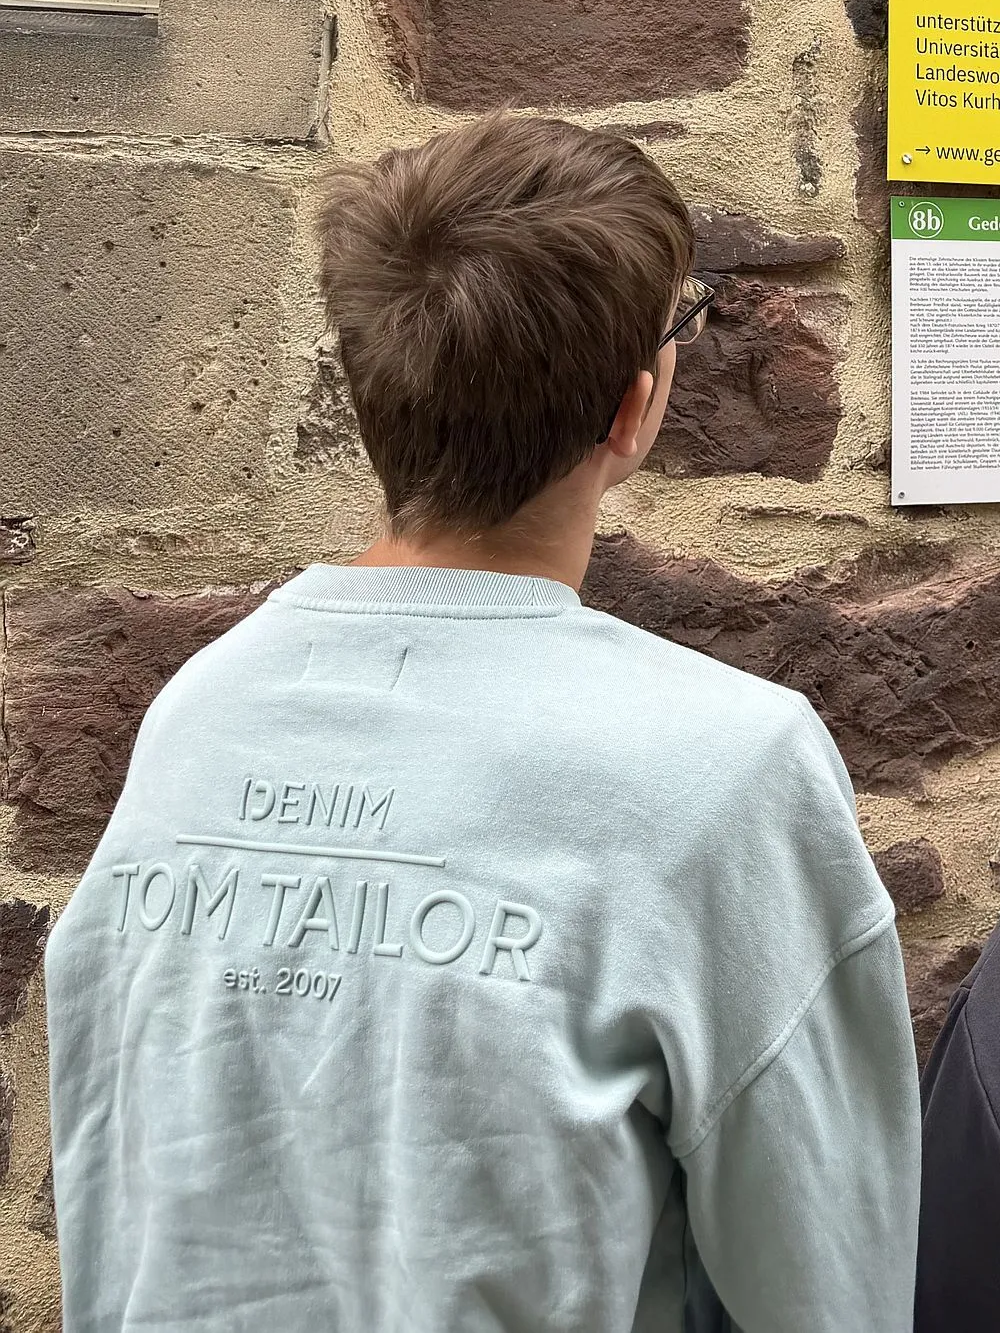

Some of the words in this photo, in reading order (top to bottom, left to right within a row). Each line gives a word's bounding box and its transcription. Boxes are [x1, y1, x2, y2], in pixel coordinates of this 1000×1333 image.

[915, 89, 957, 108] Vitos
[913, 210, 939, 231] 8b
[240, 778, 395, 828] DENIM
[112, 863, 240, 939] TOM
[261, 873, 542, 979] TAILOR
[224, 968, 266, 993] est.
[277, 968, 341, 1000] 2007
